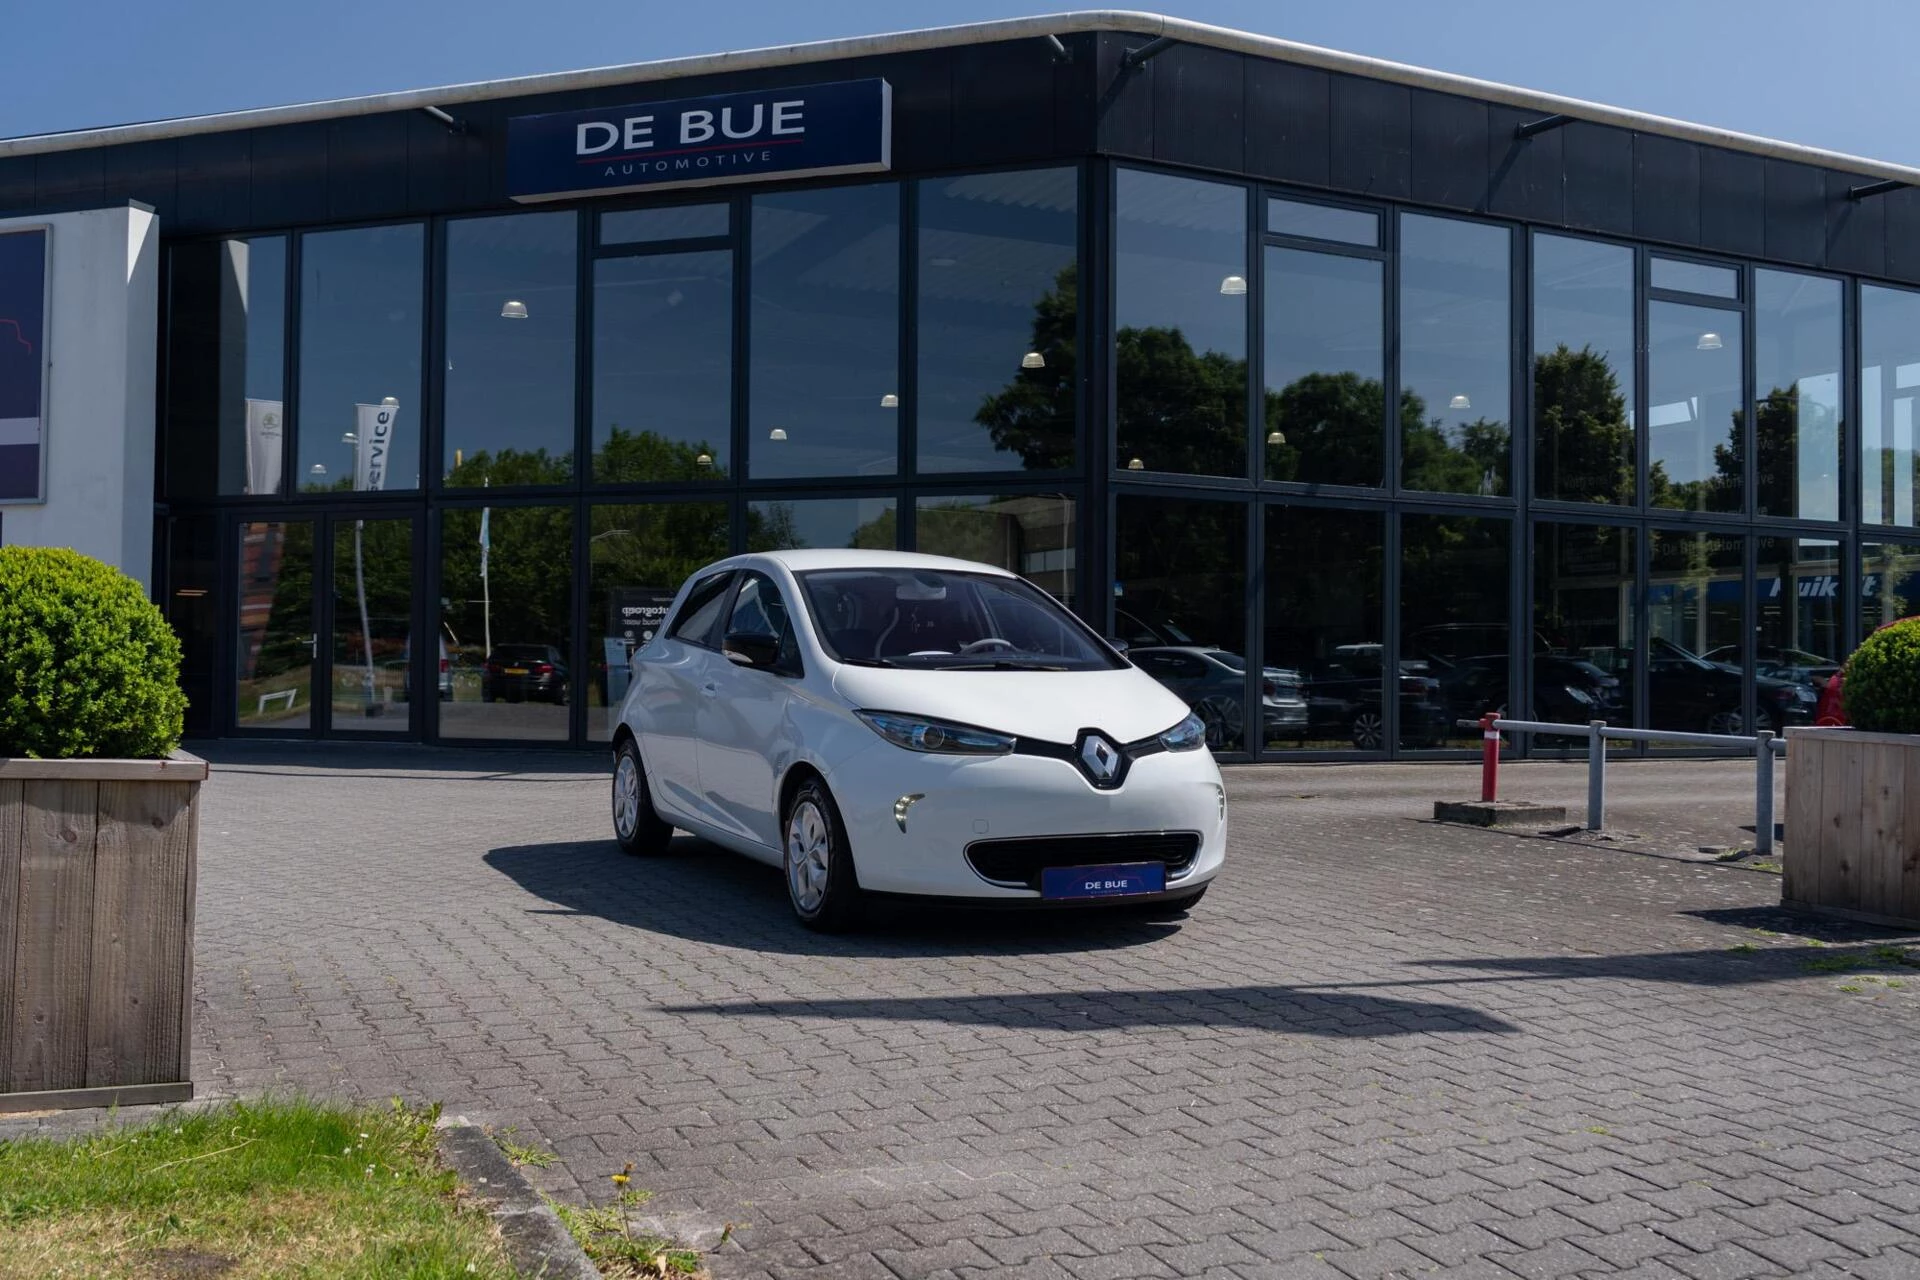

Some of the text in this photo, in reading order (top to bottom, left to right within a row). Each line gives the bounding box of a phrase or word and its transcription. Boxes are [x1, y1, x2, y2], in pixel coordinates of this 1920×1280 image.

[576, 99, 805, 156] DE BUE
[604, 150, 772, 178] AUTOMOTIVE
[1085, 880, 1128, 890] DE BUE
